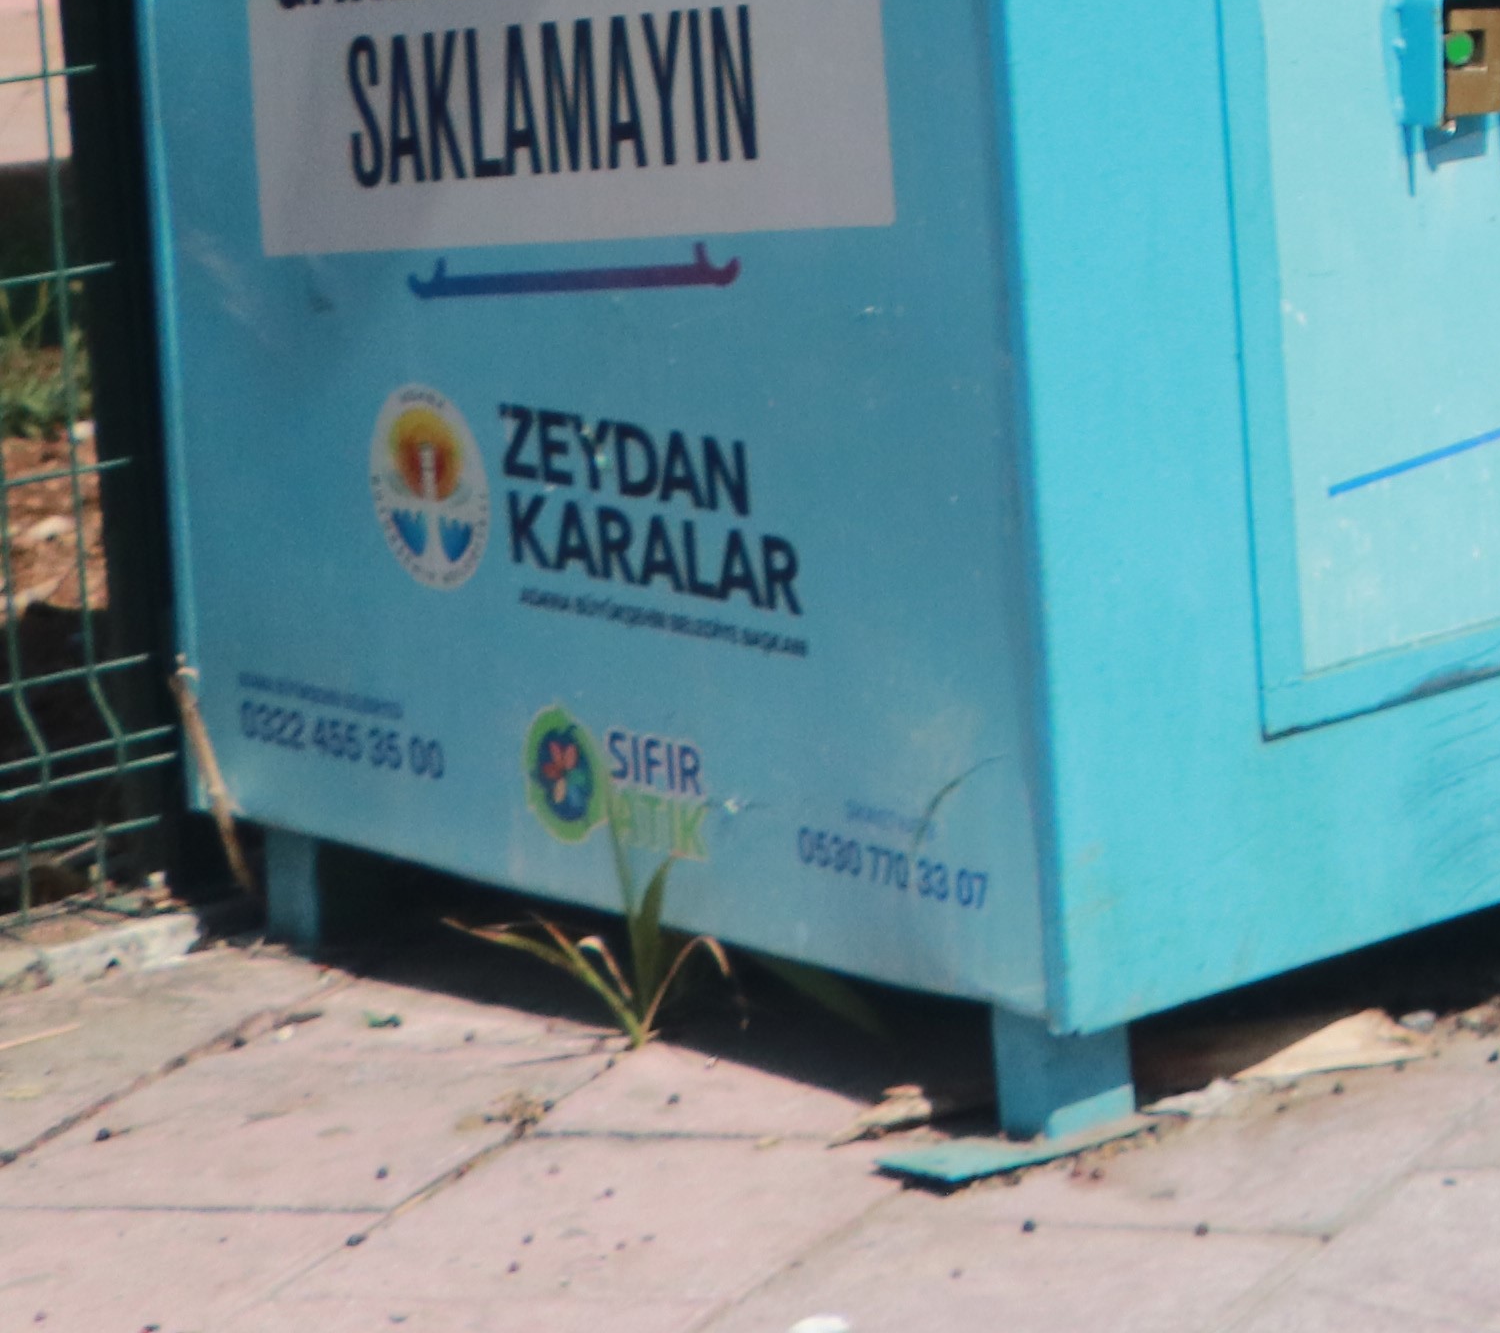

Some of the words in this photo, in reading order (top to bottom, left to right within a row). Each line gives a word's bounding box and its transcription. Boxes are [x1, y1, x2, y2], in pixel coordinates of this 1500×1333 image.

[346, 4, 759, 189] SAKLAMAYIN
[497, 401, 751, 518] ZEYDAN
[506, 490, 803, 616] KARALAR
[239, 700, 305, 751] 0322
[312, 714, 362, 762] 455
[367, 724, 403, 771] 35
[408, 735, 446, 781] 00
[606, 730, 702, 796] SIFIR
[866, 843, 909, 891] 770
[955, 867, 990, 911] 07
